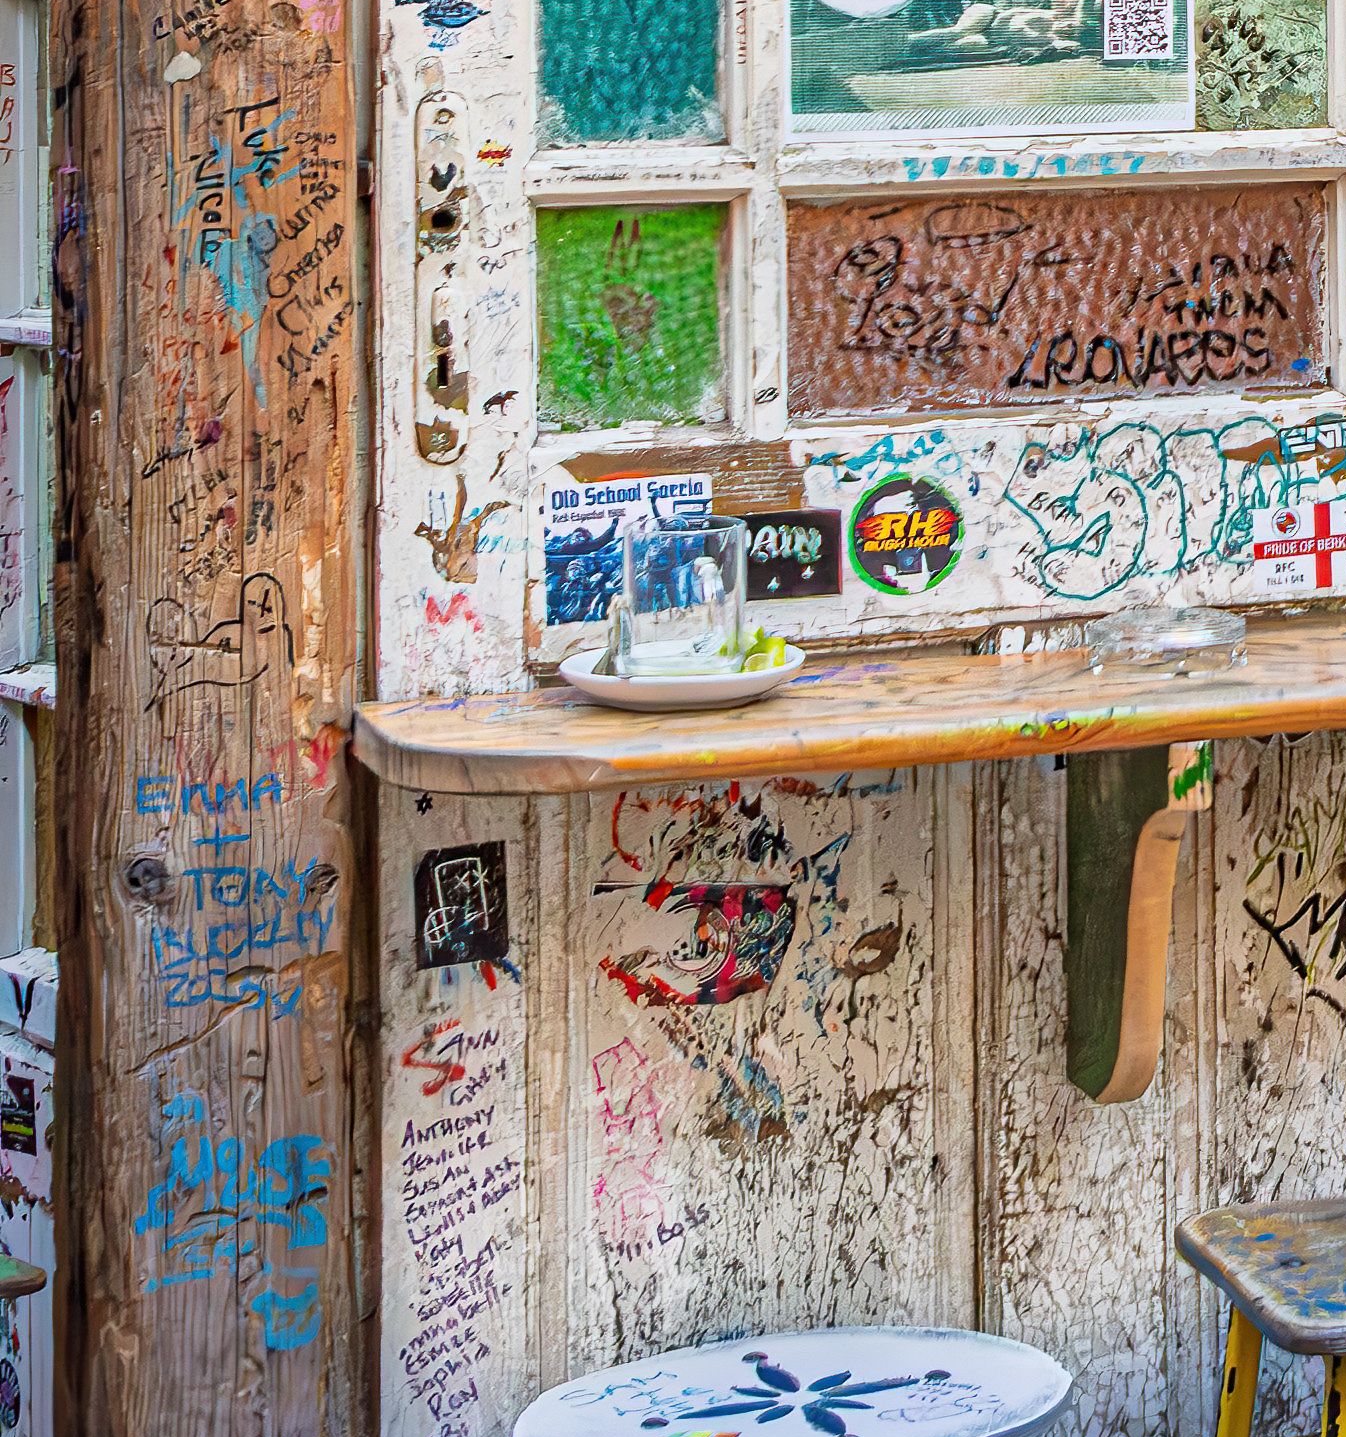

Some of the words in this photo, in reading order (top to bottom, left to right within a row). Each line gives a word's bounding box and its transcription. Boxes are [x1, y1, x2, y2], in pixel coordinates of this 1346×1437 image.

[552, 488, 579, 509] Old
[585, 482, 641, 507] School
[881, 511, 943, 540] RH
[1298, 538, 1315, 554] OF
